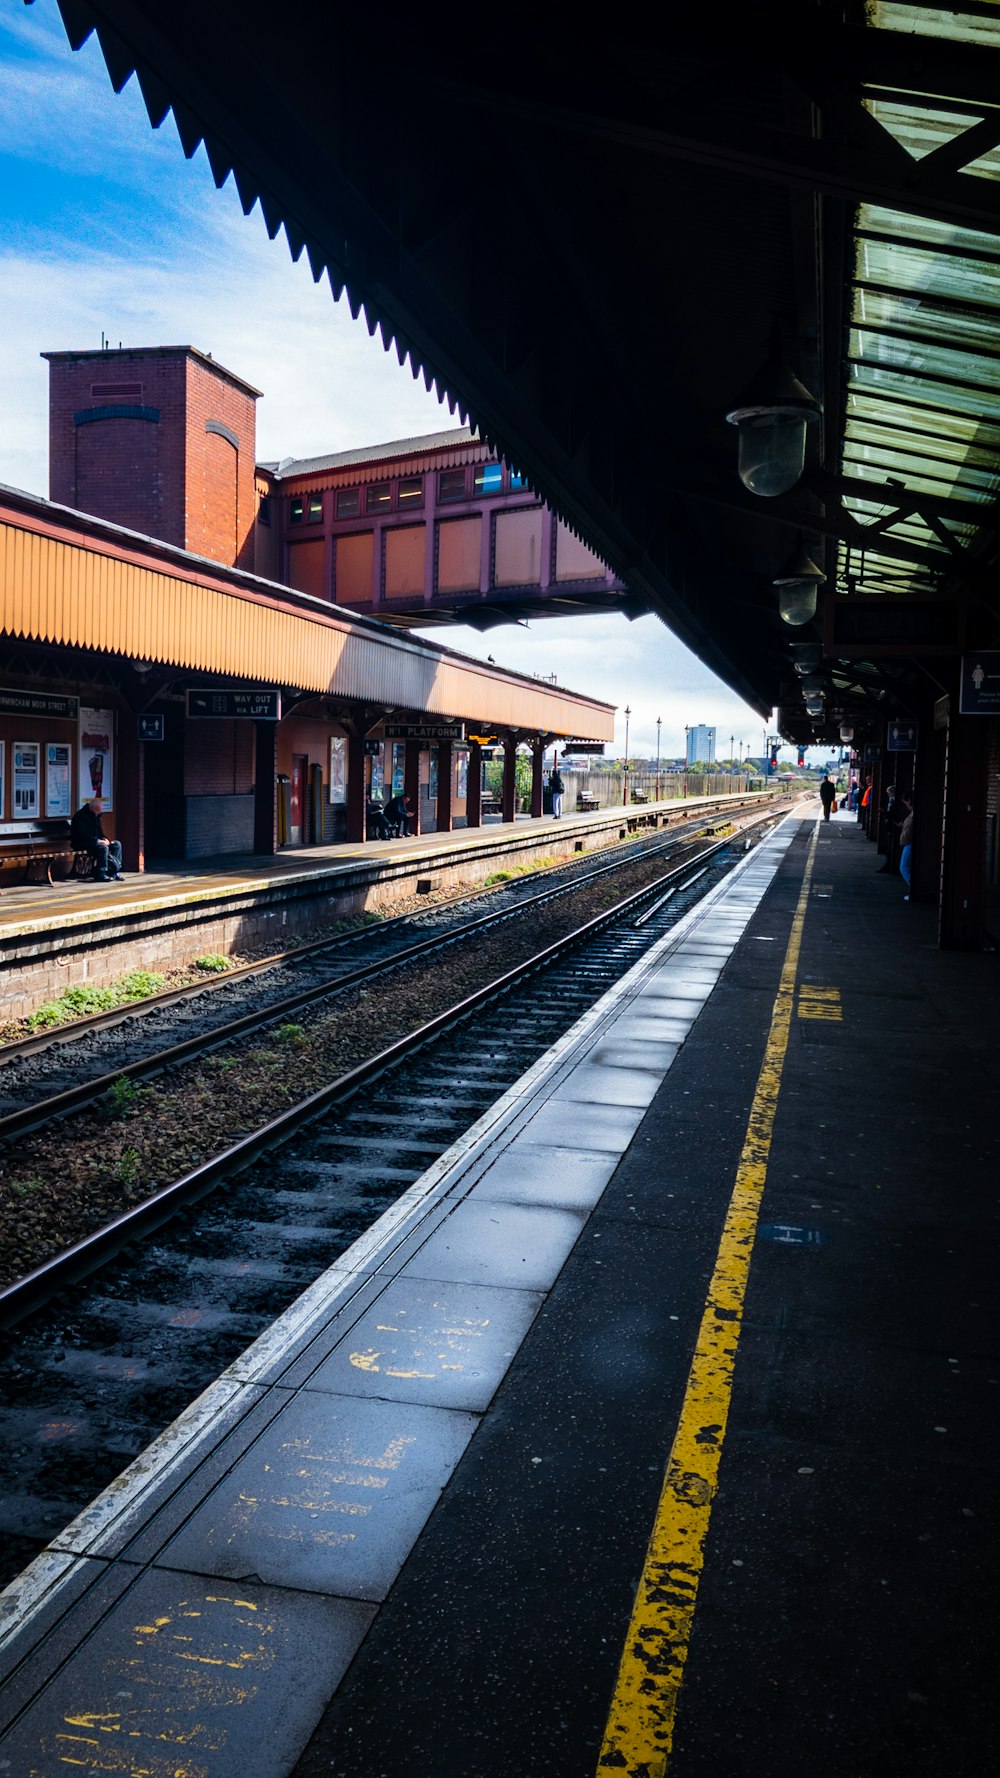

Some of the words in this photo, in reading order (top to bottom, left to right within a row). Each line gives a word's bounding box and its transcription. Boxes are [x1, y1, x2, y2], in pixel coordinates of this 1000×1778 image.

[234, 695, 252, 703] WAY
[255, 695, 271, 703] OUT
[48, 701, 66, 711] STREET
[250, 706, 269, 714] LIFT
[407, 727, 458, 736] PLATFORM
[27, 1596, 277, 1778] IND
